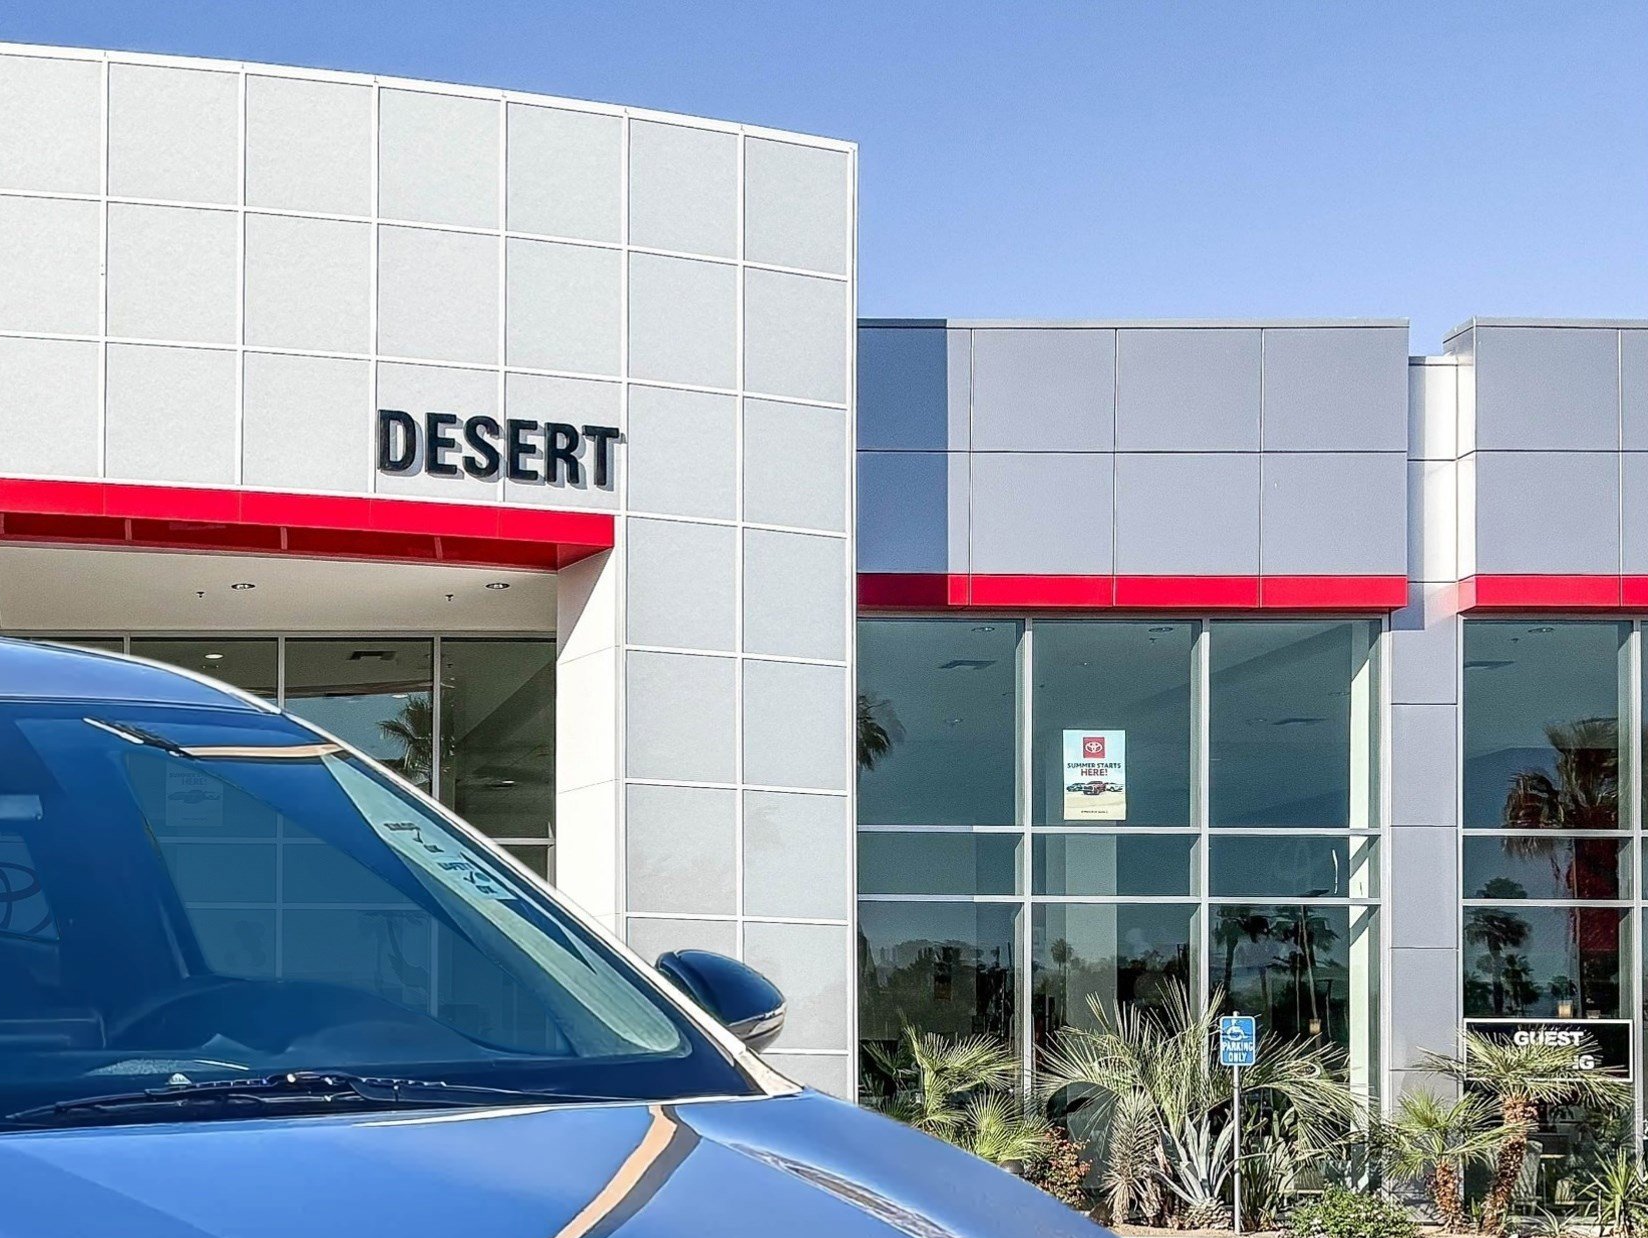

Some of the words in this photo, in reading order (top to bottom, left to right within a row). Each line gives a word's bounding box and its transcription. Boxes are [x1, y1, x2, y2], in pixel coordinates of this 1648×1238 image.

[378, 409, 620, 486] DESERT
[1513, 1031, 1584, 1047] GUEST
[1222, 1041, 1254, 1052] PARKING
[1228, 1051, 1248, 1062] ONLY
